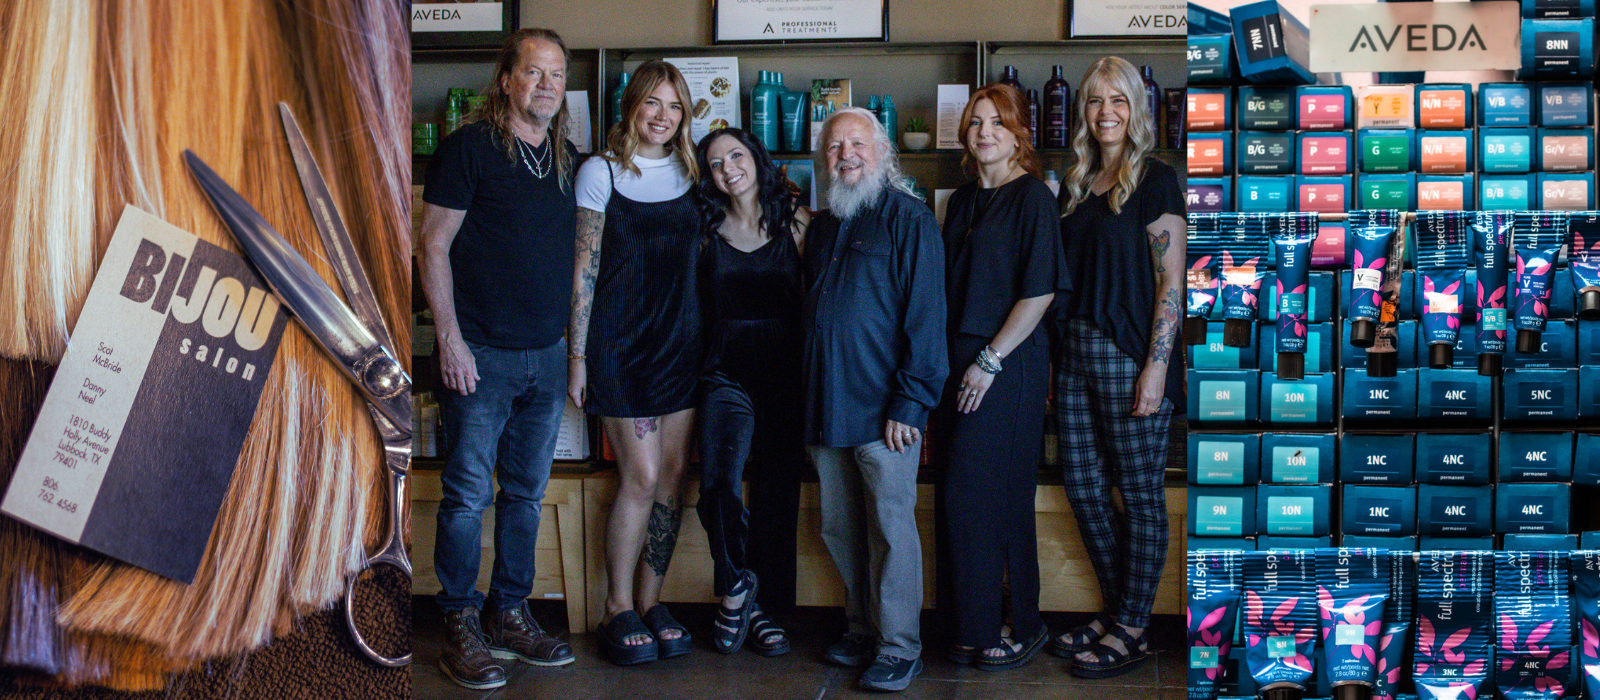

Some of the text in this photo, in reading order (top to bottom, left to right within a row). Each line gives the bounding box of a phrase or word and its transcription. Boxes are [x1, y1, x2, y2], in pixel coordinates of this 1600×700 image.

[413, 9, 461, 21] AVEDA
[1128, 15, 1187, 28] AVEDA
[1250, 28, 1263, 50] 7NN
[1349, 23, 1487, 52] AVEDA
[1546, 40, 1568, 50] 8NN
[1423, 99, 1441, 110] N/N
[1488, 97, 1506, 108] V/B
[1546, 95, 1563, 106] V/B
[1248, 101, 1265, 112] B/G
[1308, 104, 1316, 113] P
[1374, 102, 1379, 114] Y
[1248, 145, 1265, 156] B/G
[1310, 146, 1317, 156] P
[1372, 146, 1380, 155] G
[1424, 145, 1442, 156] N/N
[1488, 144, 1505, 155] B/B
[1545, 145, 1565, 155] Gr/V
[1251, 191, 1258, 200] B
[1308, 193, 1316, 203] P
[1372, 190, 1379, 199] G
[1421, 190, 1440, 201] N/N
[1486, 188, 1504, 200] B/B
[1545, 189, 1565, 199] Gr/V
[1527, 234, 1538, 249] full
[1284, 252, 1294, 267] full
[1484, 253, 1493, 268] full
[1523, 280, 1530, 288] V
[120, 238, 280, 350] BIJOU
[1282, 299, 1288, 307] B
[98, 342, 113, 355] Scot
[1210, 343, 1224, 352] 8N
[92, 354, 121, 373] McBride
[180, 338, 256, 381] salon
[83, 377, 106, 397] Danny
[78, 390, 97, 404] Neel
[1216, 391, 1230, 400] 8N
[1285, 393, 1304, 402] 10N
[1369, 390, 1389, 399] 1NC
[1445, 390, 1466, 400] 4NC
[1531, 390, 1552, 400] 5NC
[70, 414, 111, 443] 1810 Buddy
[63, 426, 109, 454] Holly Avenue
[58, 439, 101, 465] Lubbock, TX
[1214, 452, 1228, 461] 8N
[1526, 451, 1547, 461] 4NC
[53, 451, 77, 469] 79401
[1287, 457, 1306, 466] 10N
[1367, 455, 1387, 465] 1NC
[1443, 455, 1464, 465] 4NC
[43, 476, 59, 491] 806.
[57, 499, 77, 513] 4568
[1213, 506, 1227, 515] 9N
[1282, 506, 1301, 515] 10N
[1445, 506, 1466, 516] 4NC
[1522, 505, 1543, 515] 4NC
[1369, 507, 1389, 517] 1NC
[1264, 572, 1278, 592] full
[1335, 568, 1349, 589] full
[1193, 580, 1206, 600] full
[1438, 601, 1452, 620] full
[1516, 596, 1532, 617] full
